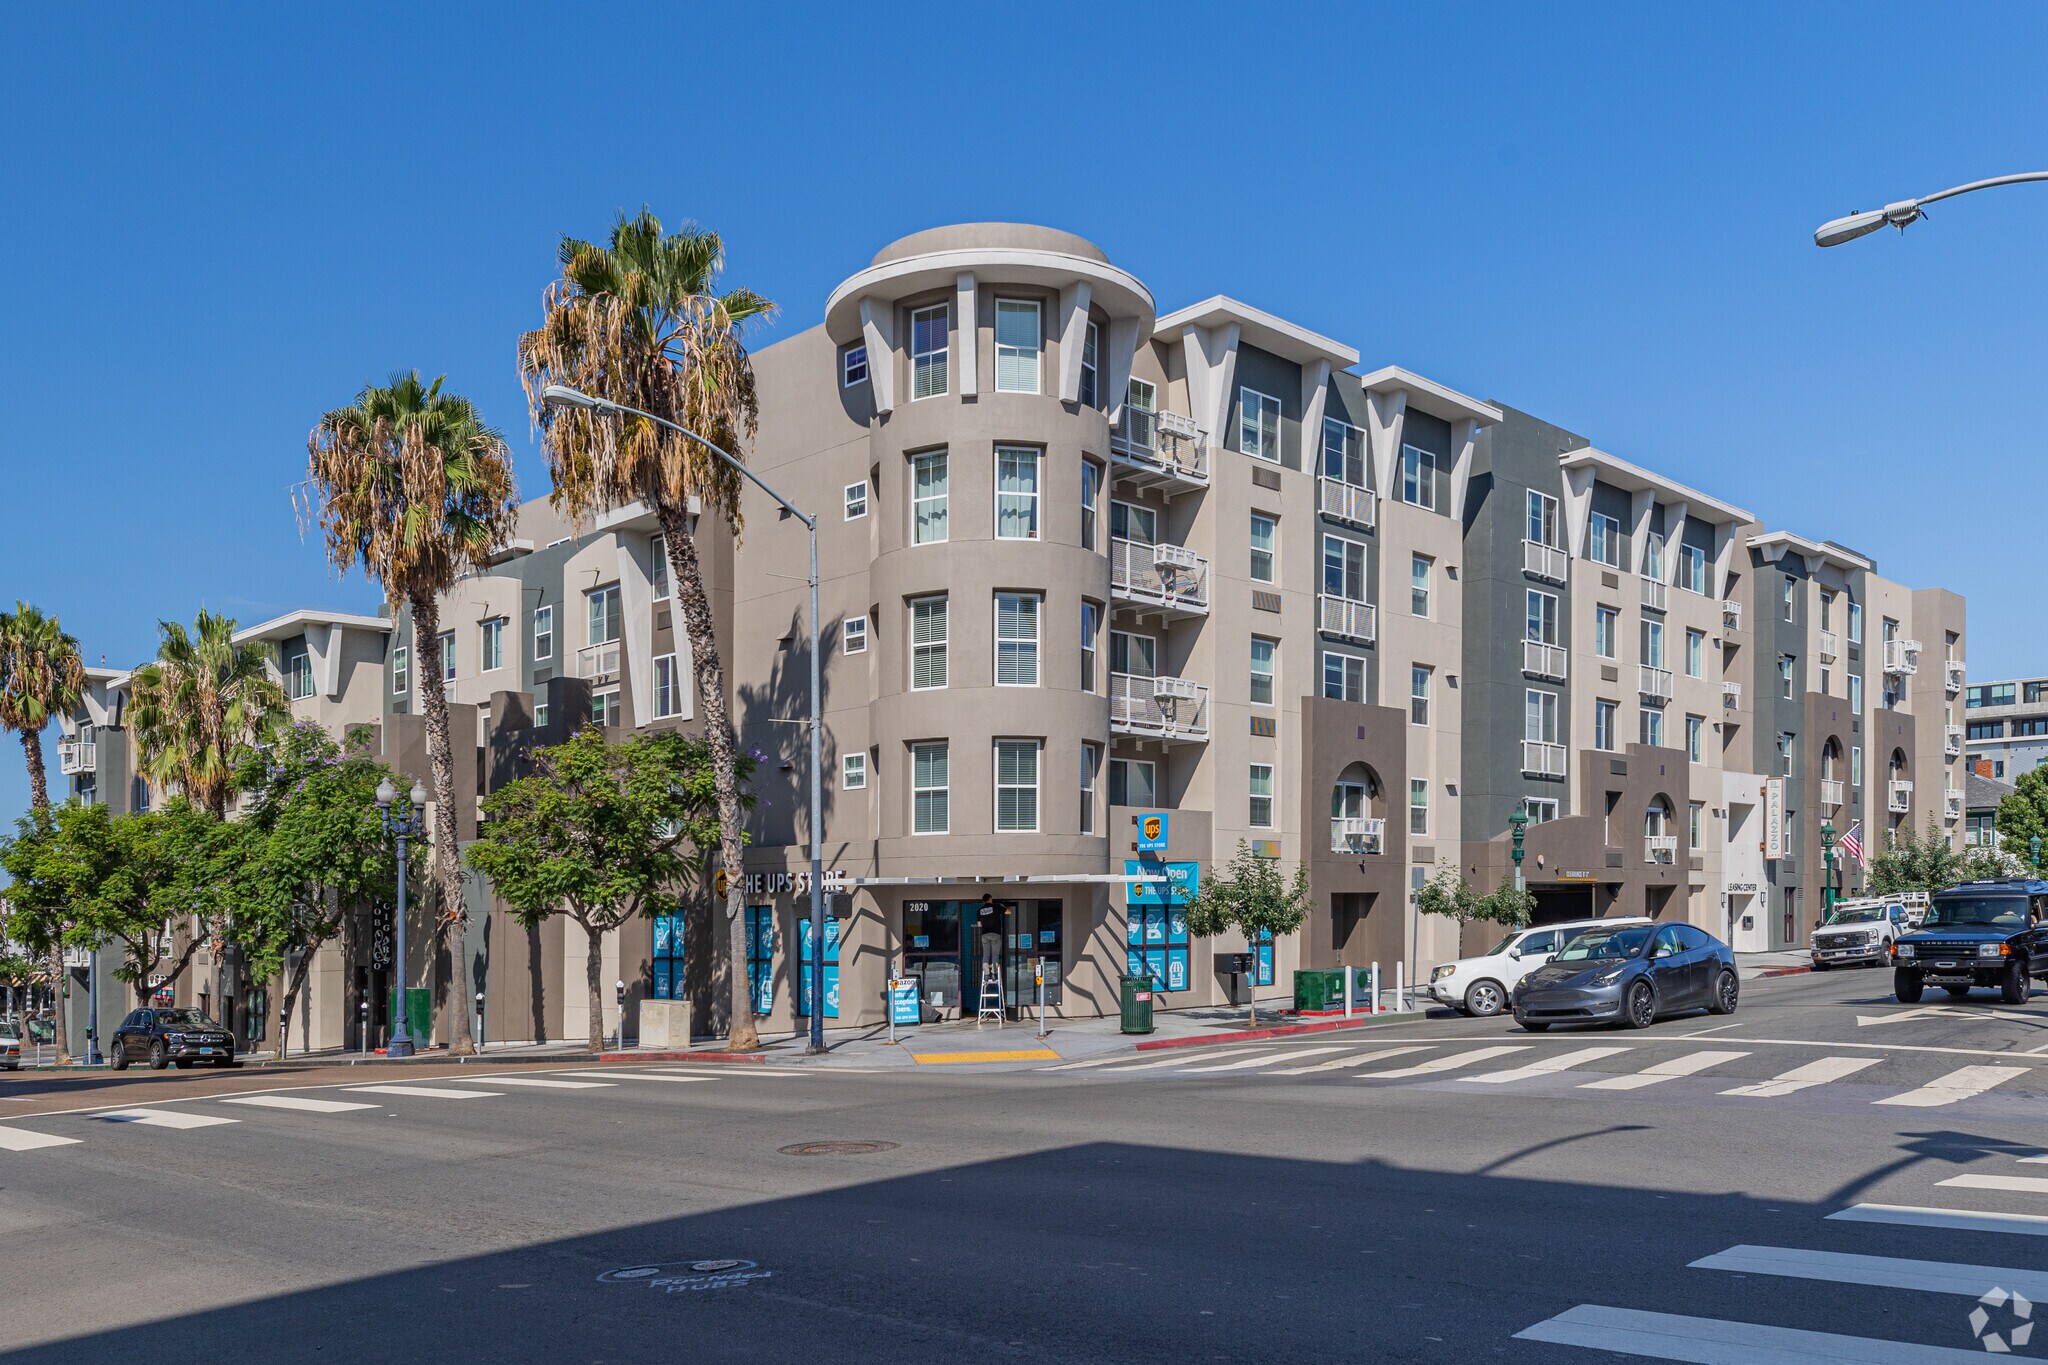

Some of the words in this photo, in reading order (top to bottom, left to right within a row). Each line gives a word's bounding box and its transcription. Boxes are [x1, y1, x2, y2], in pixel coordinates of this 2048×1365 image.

[1770, 793, 1778, 850] PALAZZO
[1145, 825, 1159, 837] ups
[1162, 866, 1187, 882] Open
[745, 873, 762, 893] HE
[767, 873, 793, 893] UPS
[798, 871, 843, 892] STRE
[1728, 883, 1743, 891] LEASING
[1743, 883, 1757, 891] CENTER
[1145, 886, 1156, 895] THE
[1157, 886, 1170, 895] UPS
[910, 903, 928, 912] 2020
[383, 902, 391, 964] CIGARS
